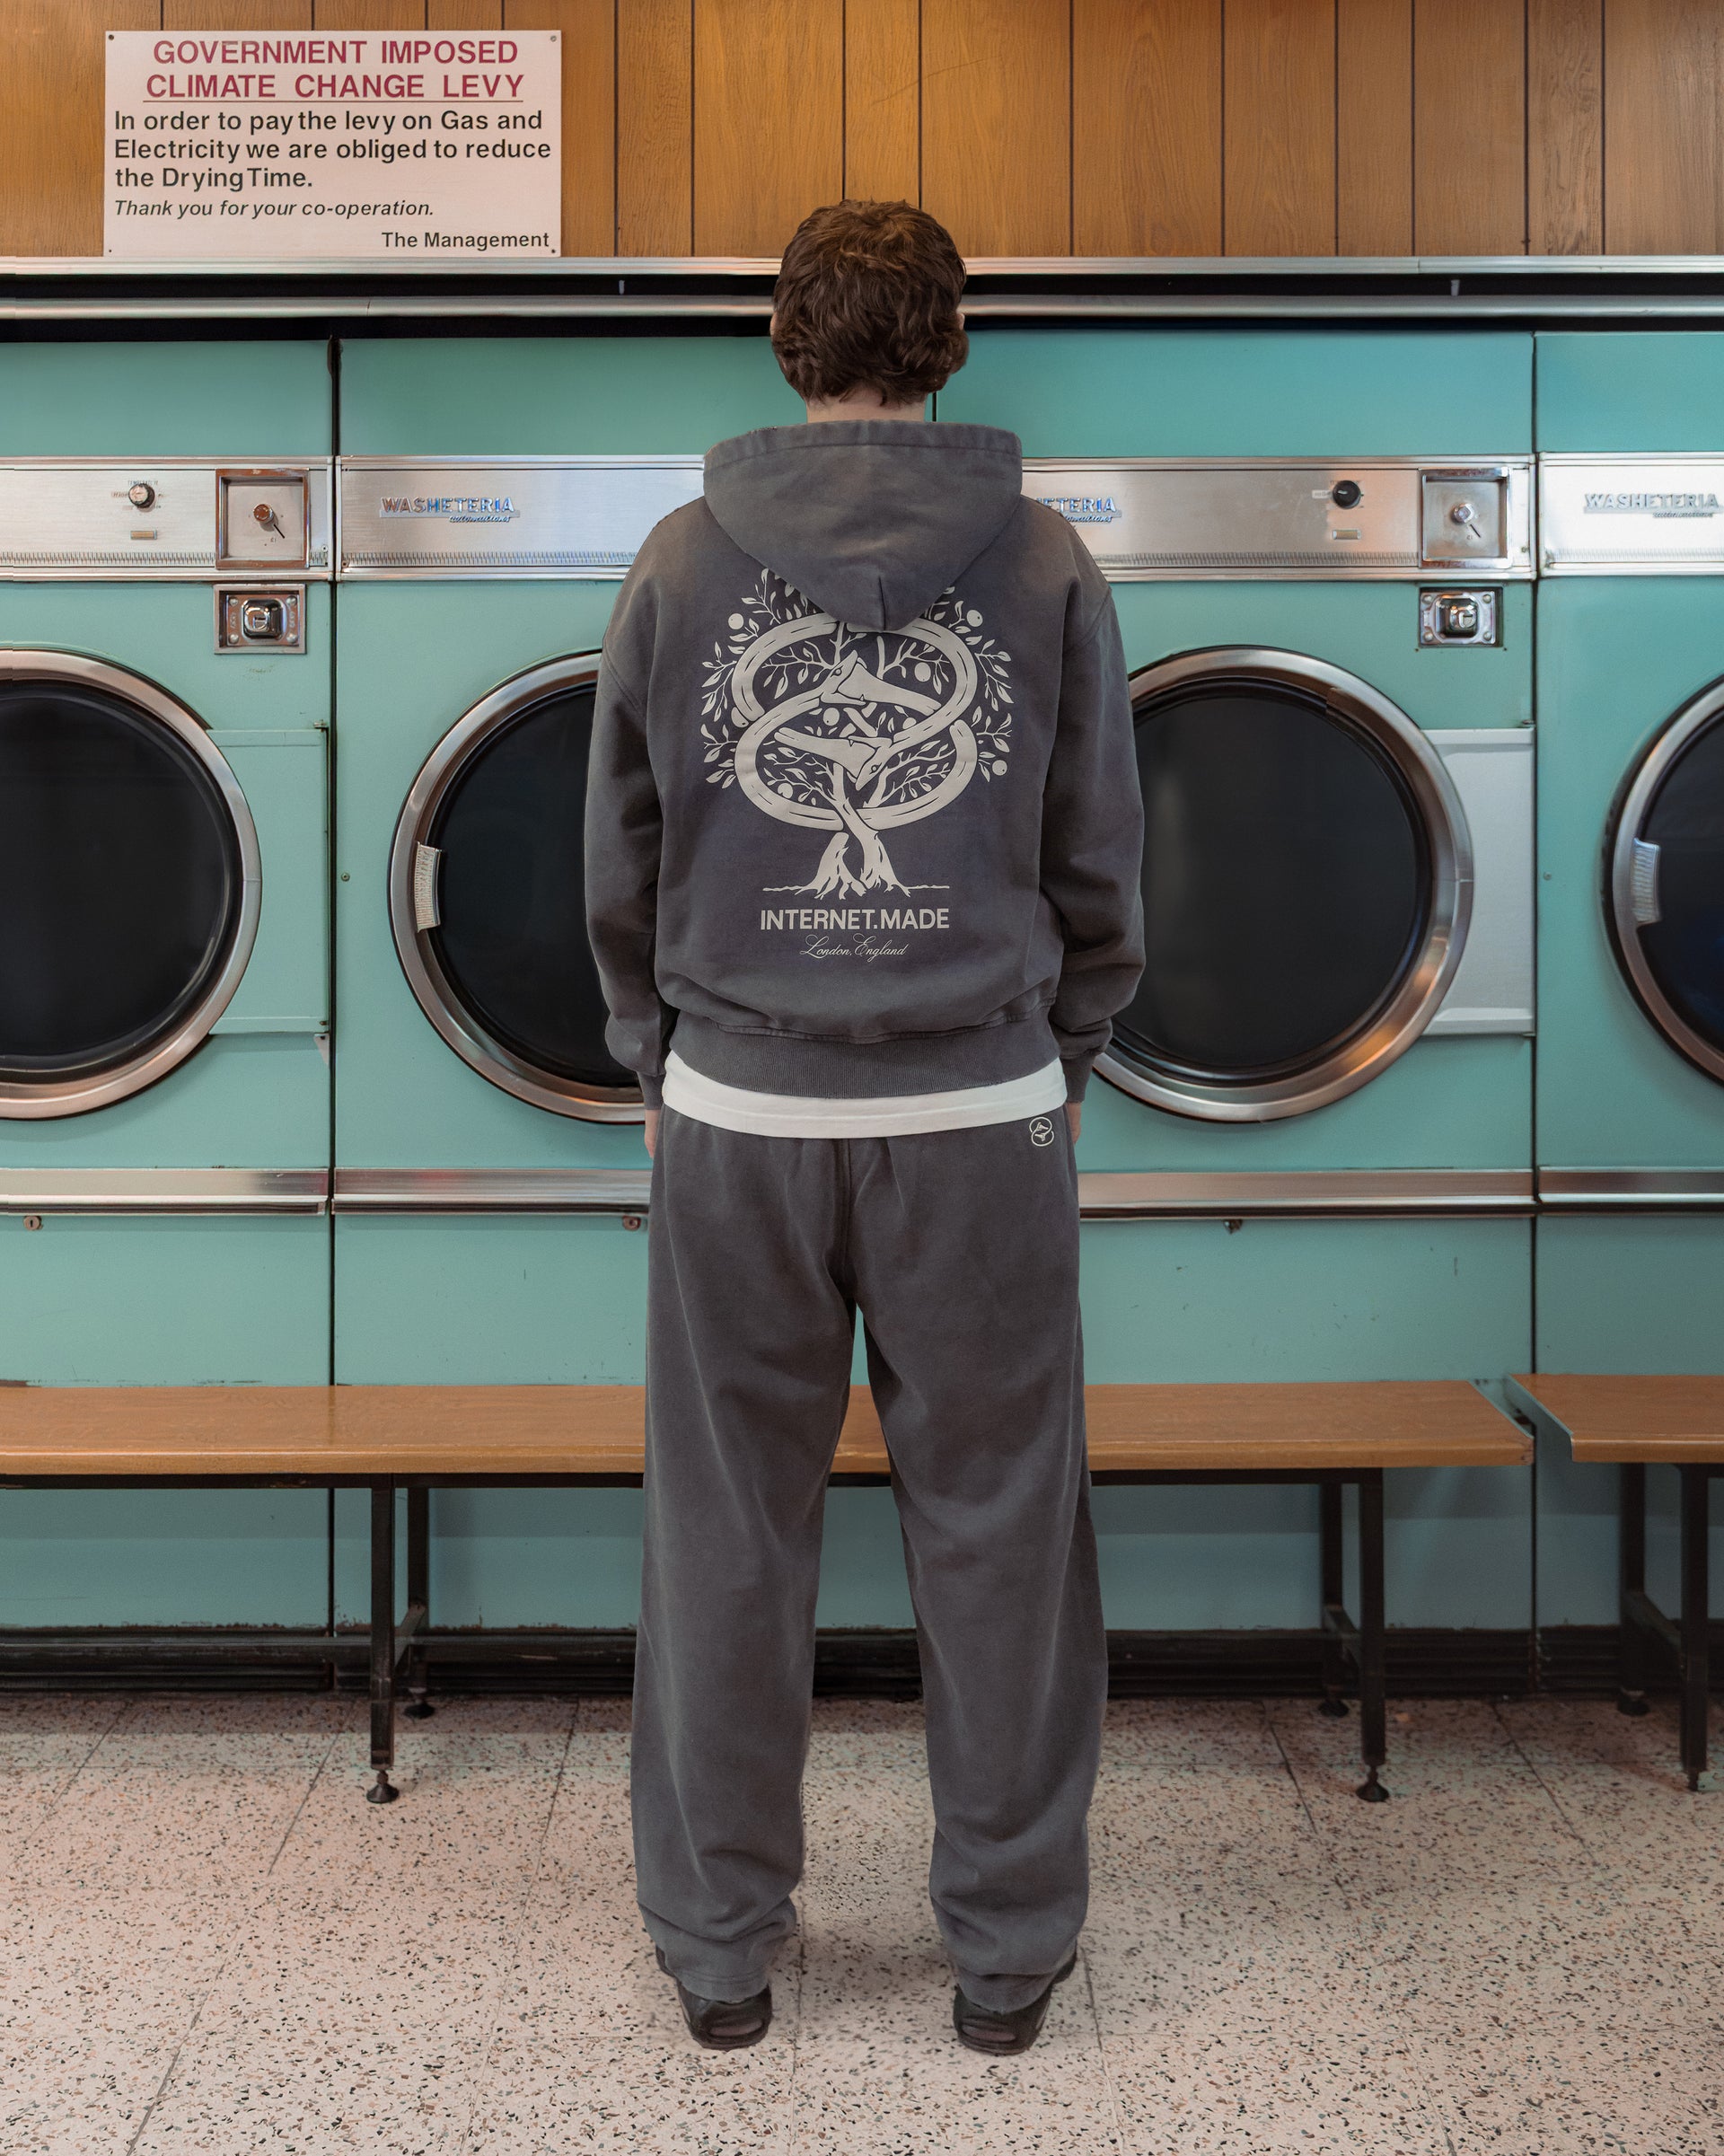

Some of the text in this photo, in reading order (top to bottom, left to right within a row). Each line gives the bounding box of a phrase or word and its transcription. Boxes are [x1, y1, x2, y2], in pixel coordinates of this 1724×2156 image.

[154, 40, 518, 65] GOVERNMENT IMPOSED
[146, 74, 524, 99] CLIMATE CHANGE LEVY
[115, 110, 542, 136] In order to pay the levy on Gas and
[115, 138, 551, 164] Electricity we are obliged to reduce
[115, 167, 313, 193] the Drying Time.
[115, 199, 435, 220] Thank you for your co-operation.
[382, 232, 550, 252] The Management
[381, 497, 515, 513] WASHETERIA
[1585, 493, 1720, 509] WASHETERIA
[761, 908, 950, 930] INTERNET.MADE
[799, 932, 910, 963] London, England
